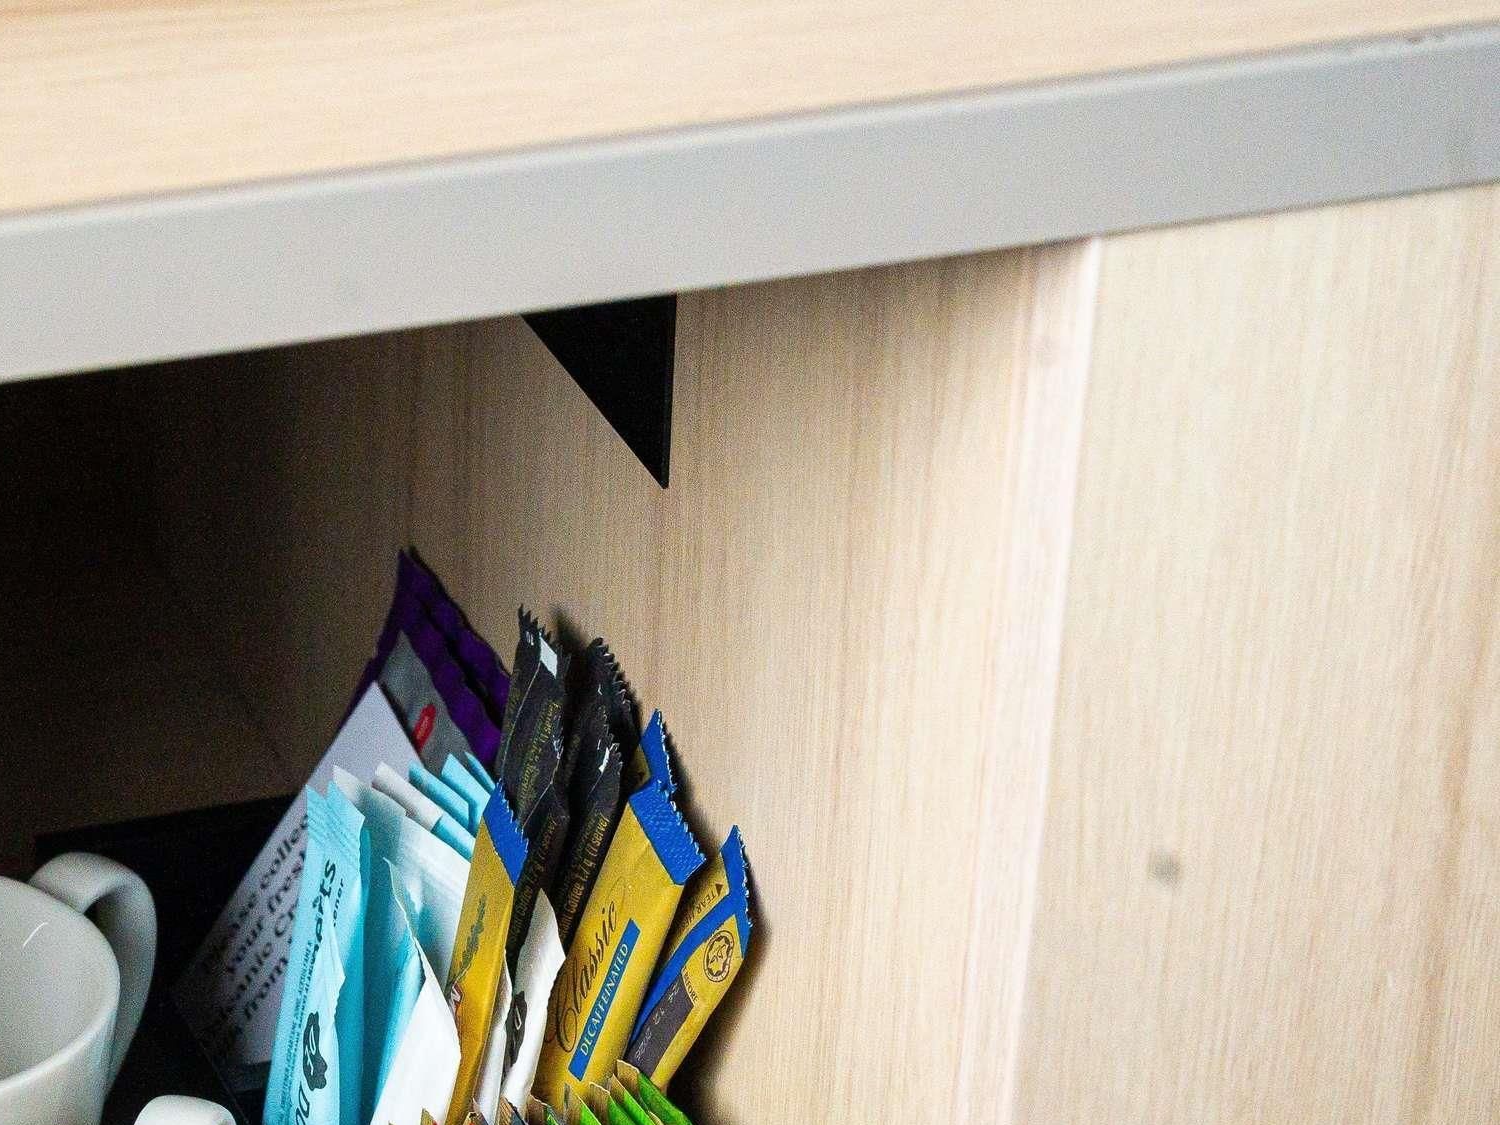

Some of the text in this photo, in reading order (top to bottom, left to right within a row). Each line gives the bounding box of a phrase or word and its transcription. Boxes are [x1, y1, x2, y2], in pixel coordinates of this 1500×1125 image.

[260, 814, 308, 890] collec
[569, 881, 585, 912] Coffee
[696, 888, 717, 921] TEAR
[547, 899, 618, 1053] Classic
[580, 943, 629, 1057] DECAFFEINATED
